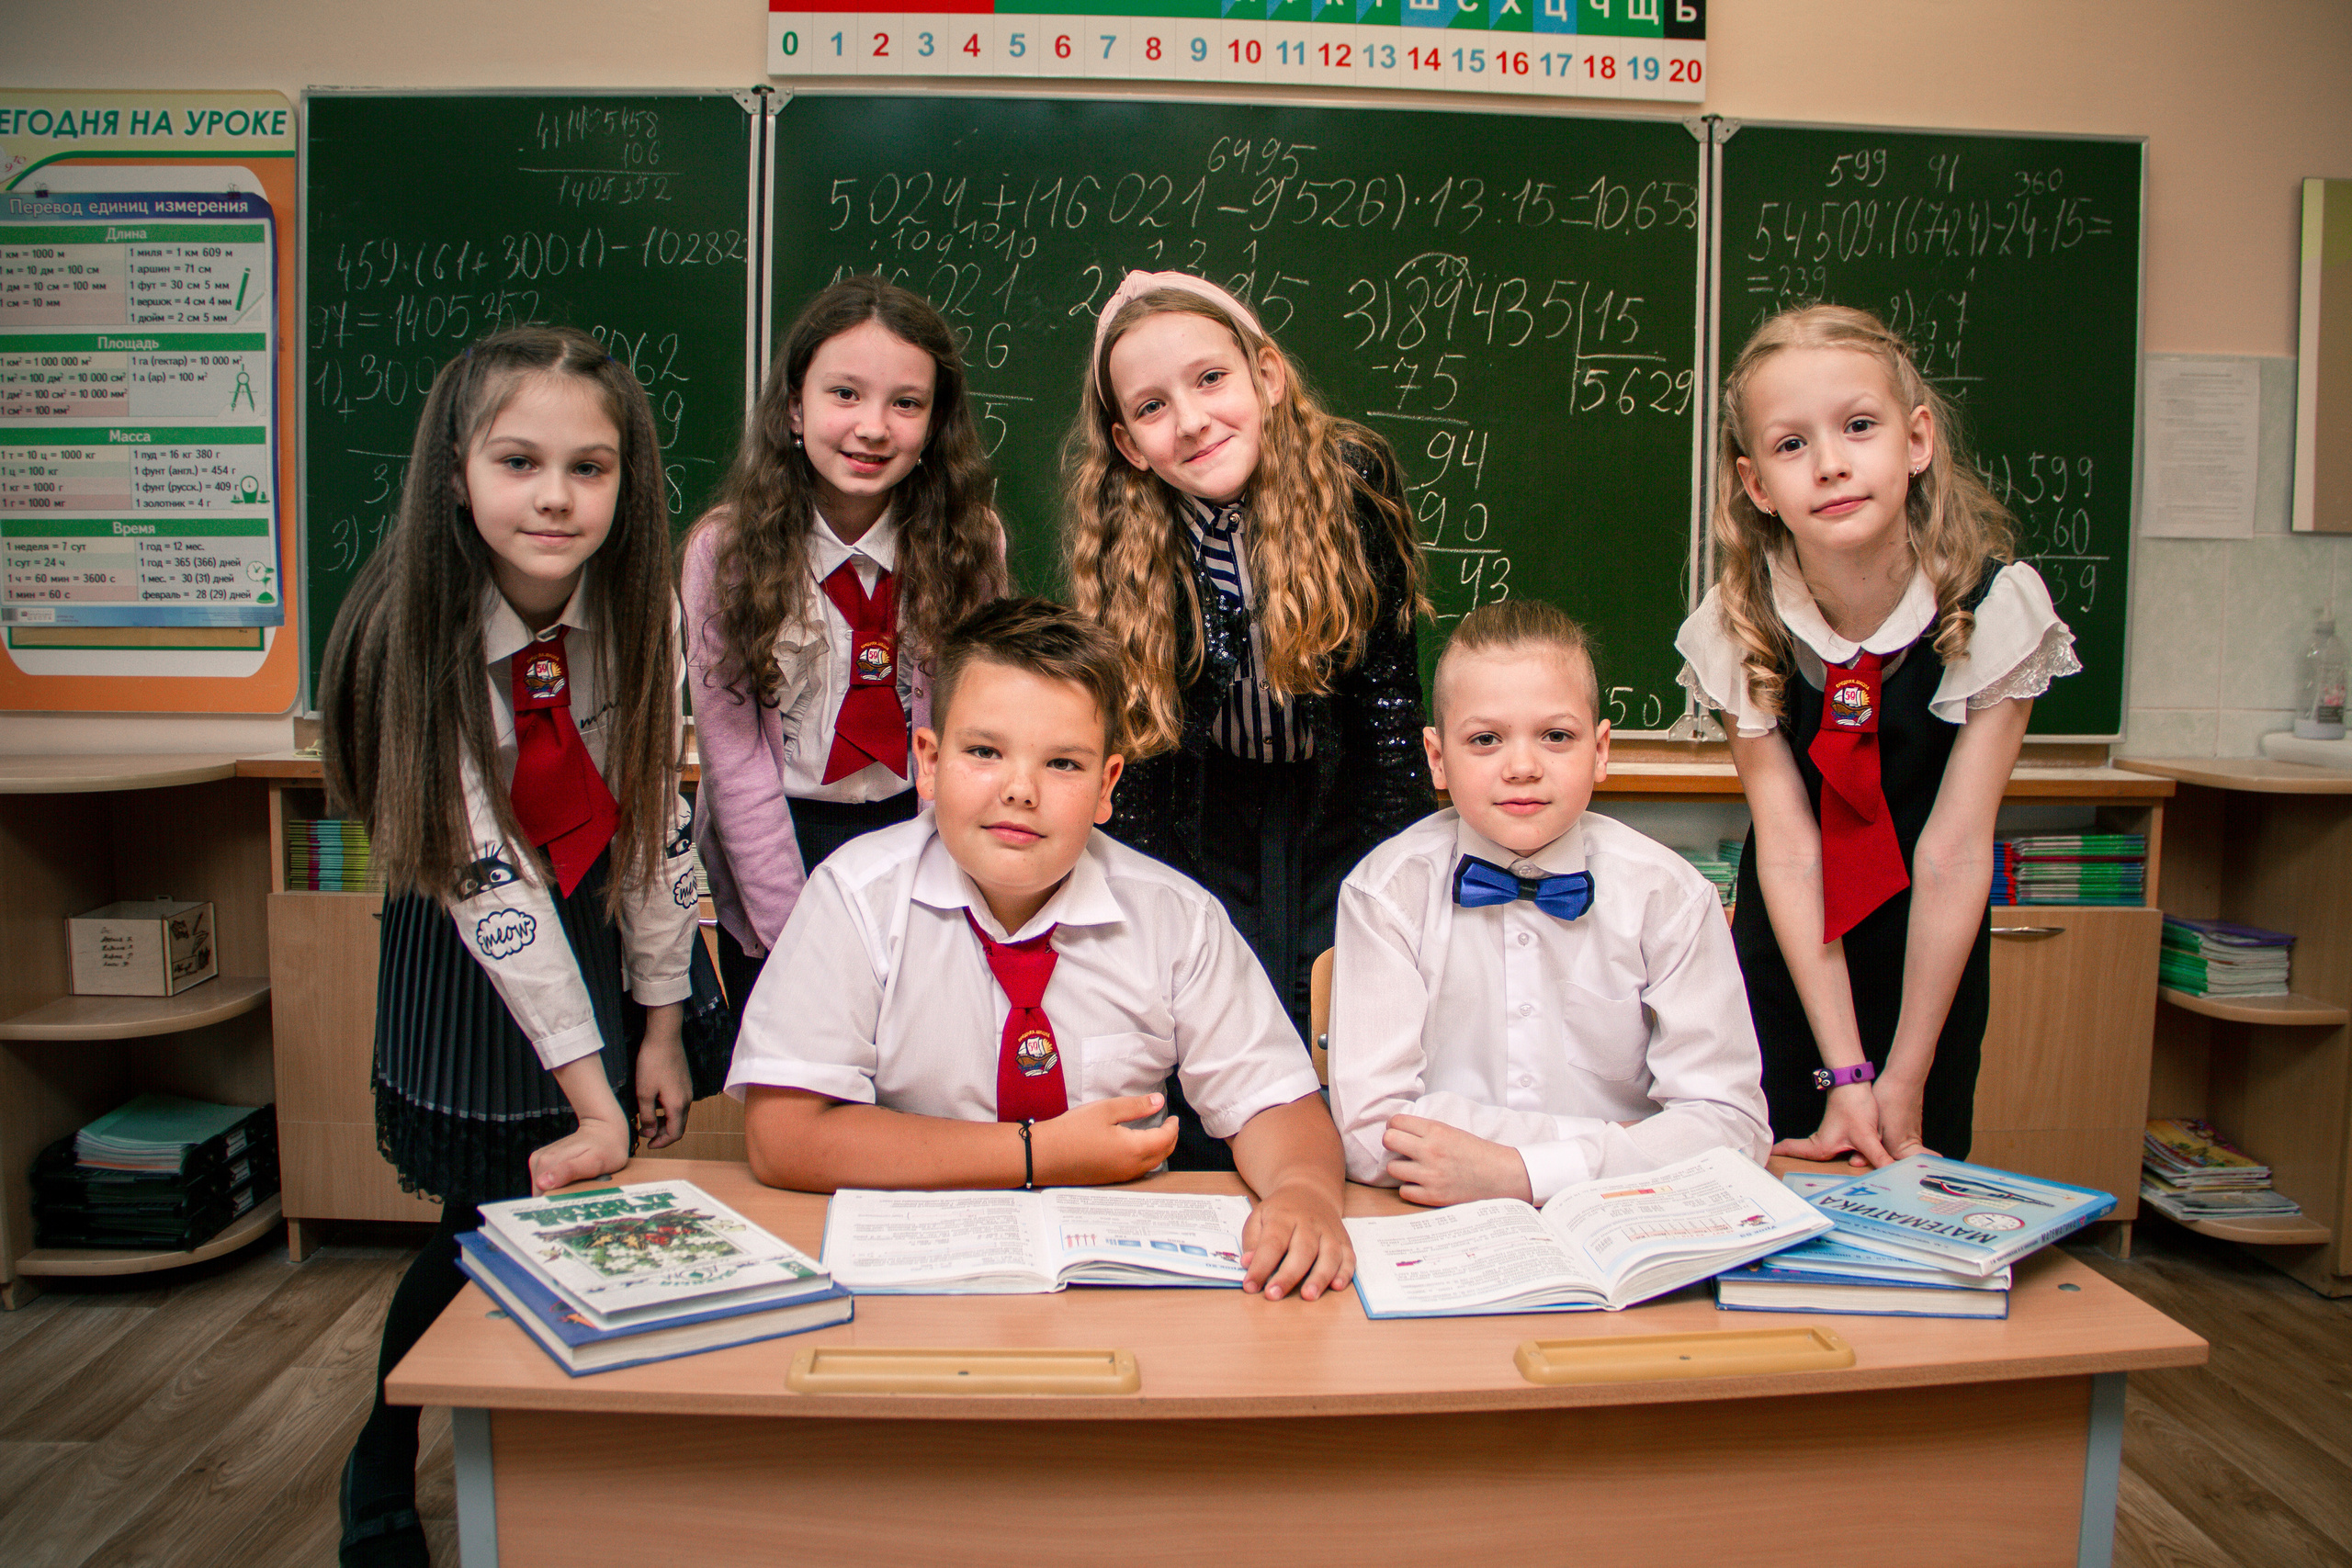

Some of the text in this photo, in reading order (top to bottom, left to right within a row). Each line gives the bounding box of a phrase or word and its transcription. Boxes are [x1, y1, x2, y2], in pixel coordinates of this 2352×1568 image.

[1628, 0, 1659, 25] Щ
[782, 31, 1702, 84] 0 1 2 3 4 5 6 7 8 9 10 11 12 13 14 15 16 17 18 19 20
[0, 109, 287, 139] ЕГОДНЯ НА УРОКЕ
[623, 140, 661, 169] 106
[1207, 135, 1317, 180] 6495
[1826, 148, 1886, 187] 599
[9, 198, 248, 217] Перевод единиц измерения
[105, 227, 147, 243] Длина
[32, 249, 54, 259] 1000
[202, 247, 222, 258] 609
[67, 265, 85, 276] 100
[137, 266, 171, 276] аршин
[184, 264, 195, 274] 71
[73, 281, 89, 291] 100
[137, 279, 184, 292] фут 30
[137, 299, 173, 309] вершок
[137, 312, 165, 325] дюйм
[97, 337, 160, 351] Площадь
[151, 355, 230, 367] (гектар) 10 000
[147, 372, 209, 384] (ар) 100 м²
[108, 429, 152, 443] Масса
[61, 450, 83, 460] 1000
[141, 452, 158, 461] пуд
[169, 449, 180, 459] 16
[196, 449, 213, 459] 380
[28, 466, 46, 477] 100
[141, 465, 229, 478] фунт (англ.) 454
[2022, 451, 2094, 504] 599
[33, 482, 56, 492] 1000
[141, 481, 232, 494] фунт (русск.) 409
[28, 497, 51, 509] 1000
[142, 501, 186, 509] золотник
[113, 522, 155, 537] Время
[15, 544, 86, 553] неделя сут
[146, 544, 163, 553] год
[173, 541, 183, 551] 12
[15, 558, 57, 570] сут 24
[147, 557, 242, 569] год 365 (366) дней
[35, 573, 48, 583] 60
[83, 573, 107, 583] 3600
[182, 573, 193, 583] 30
[195, 573, 211, 585] (31)
[212, 573, 235, 584] дней
[48, 589, 62, 600] 60
[141, 589, 252, 602] февраль 28 (29) дней
[482, 919, 532, 950] meow
[1842, 1186, 1878, 1196] 4
[1818, 1195, 1998, 1244] МАТЕМАТИКА
